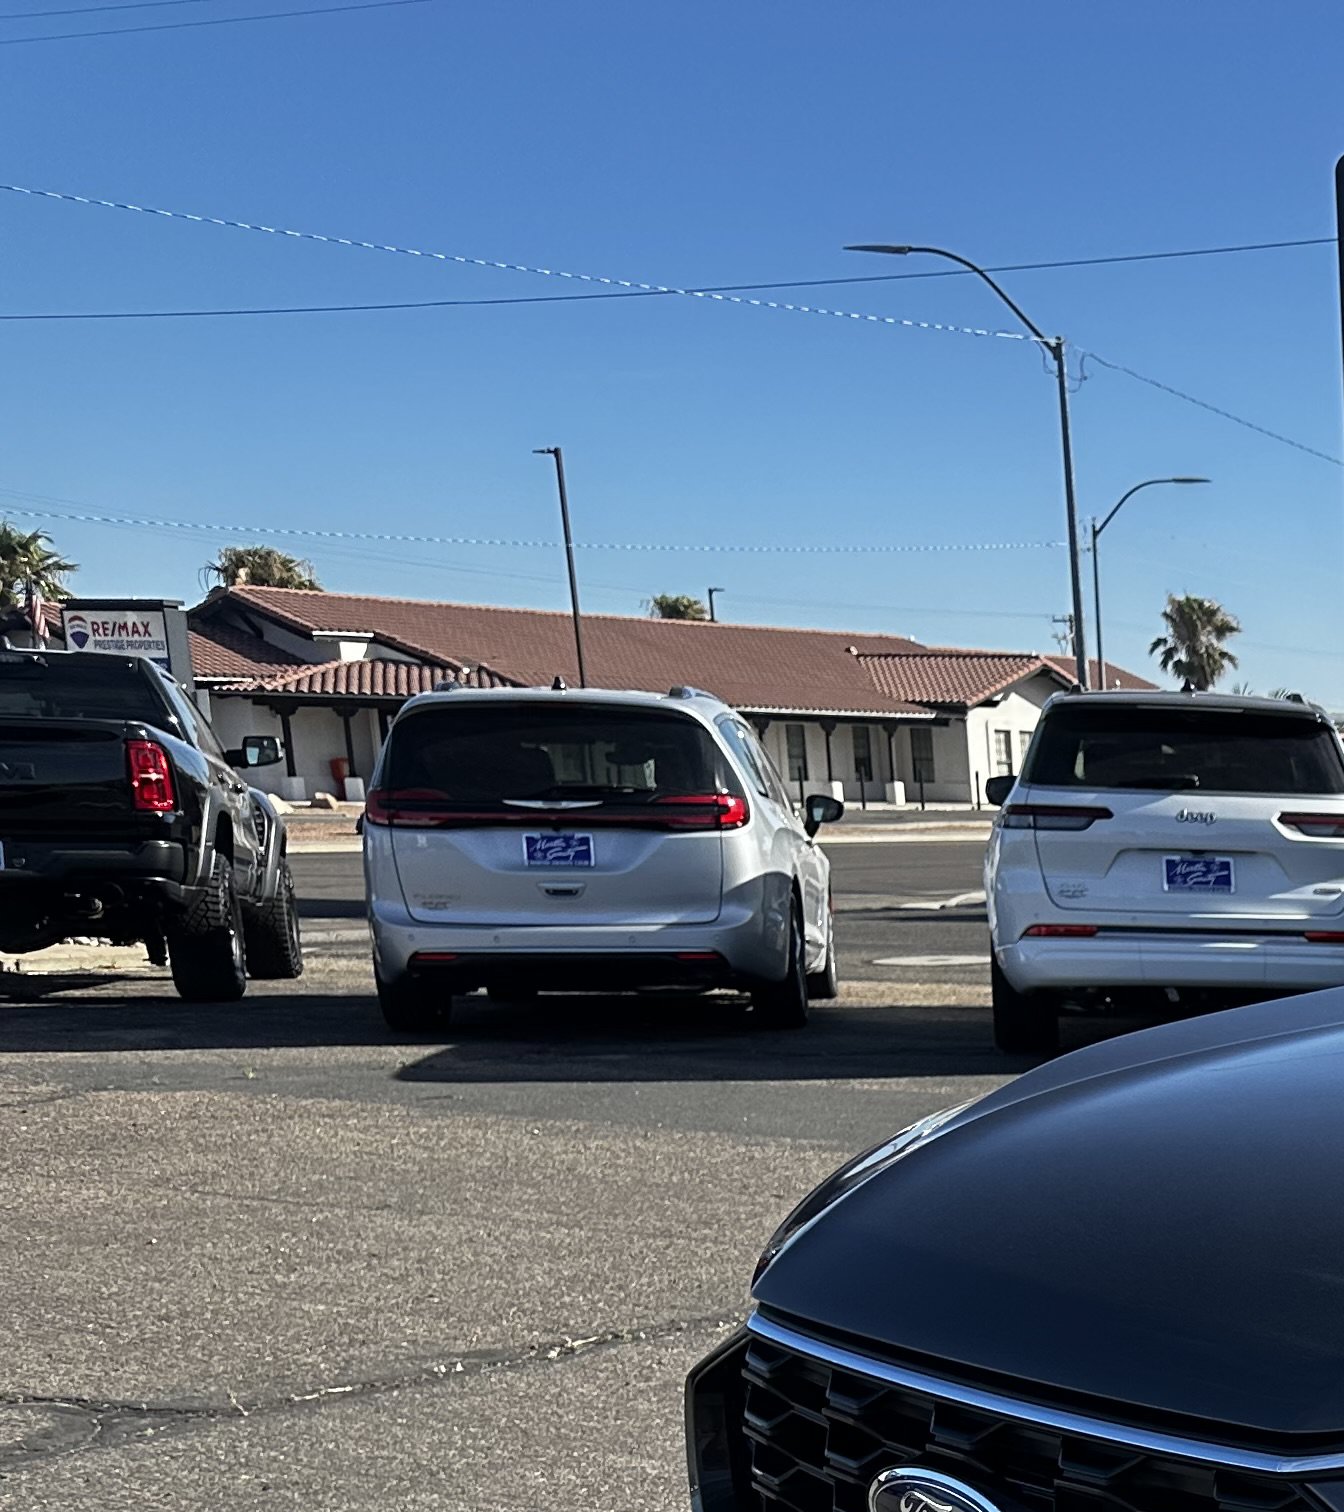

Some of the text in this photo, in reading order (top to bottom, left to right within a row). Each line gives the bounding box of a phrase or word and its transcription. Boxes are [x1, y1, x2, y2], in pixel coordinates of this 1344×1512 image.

[90, 621, 153, 638] RE/MAX
[126, 640, 166, 651] PROPERTIES
[1175, 807, 1217, 827] Jeep
